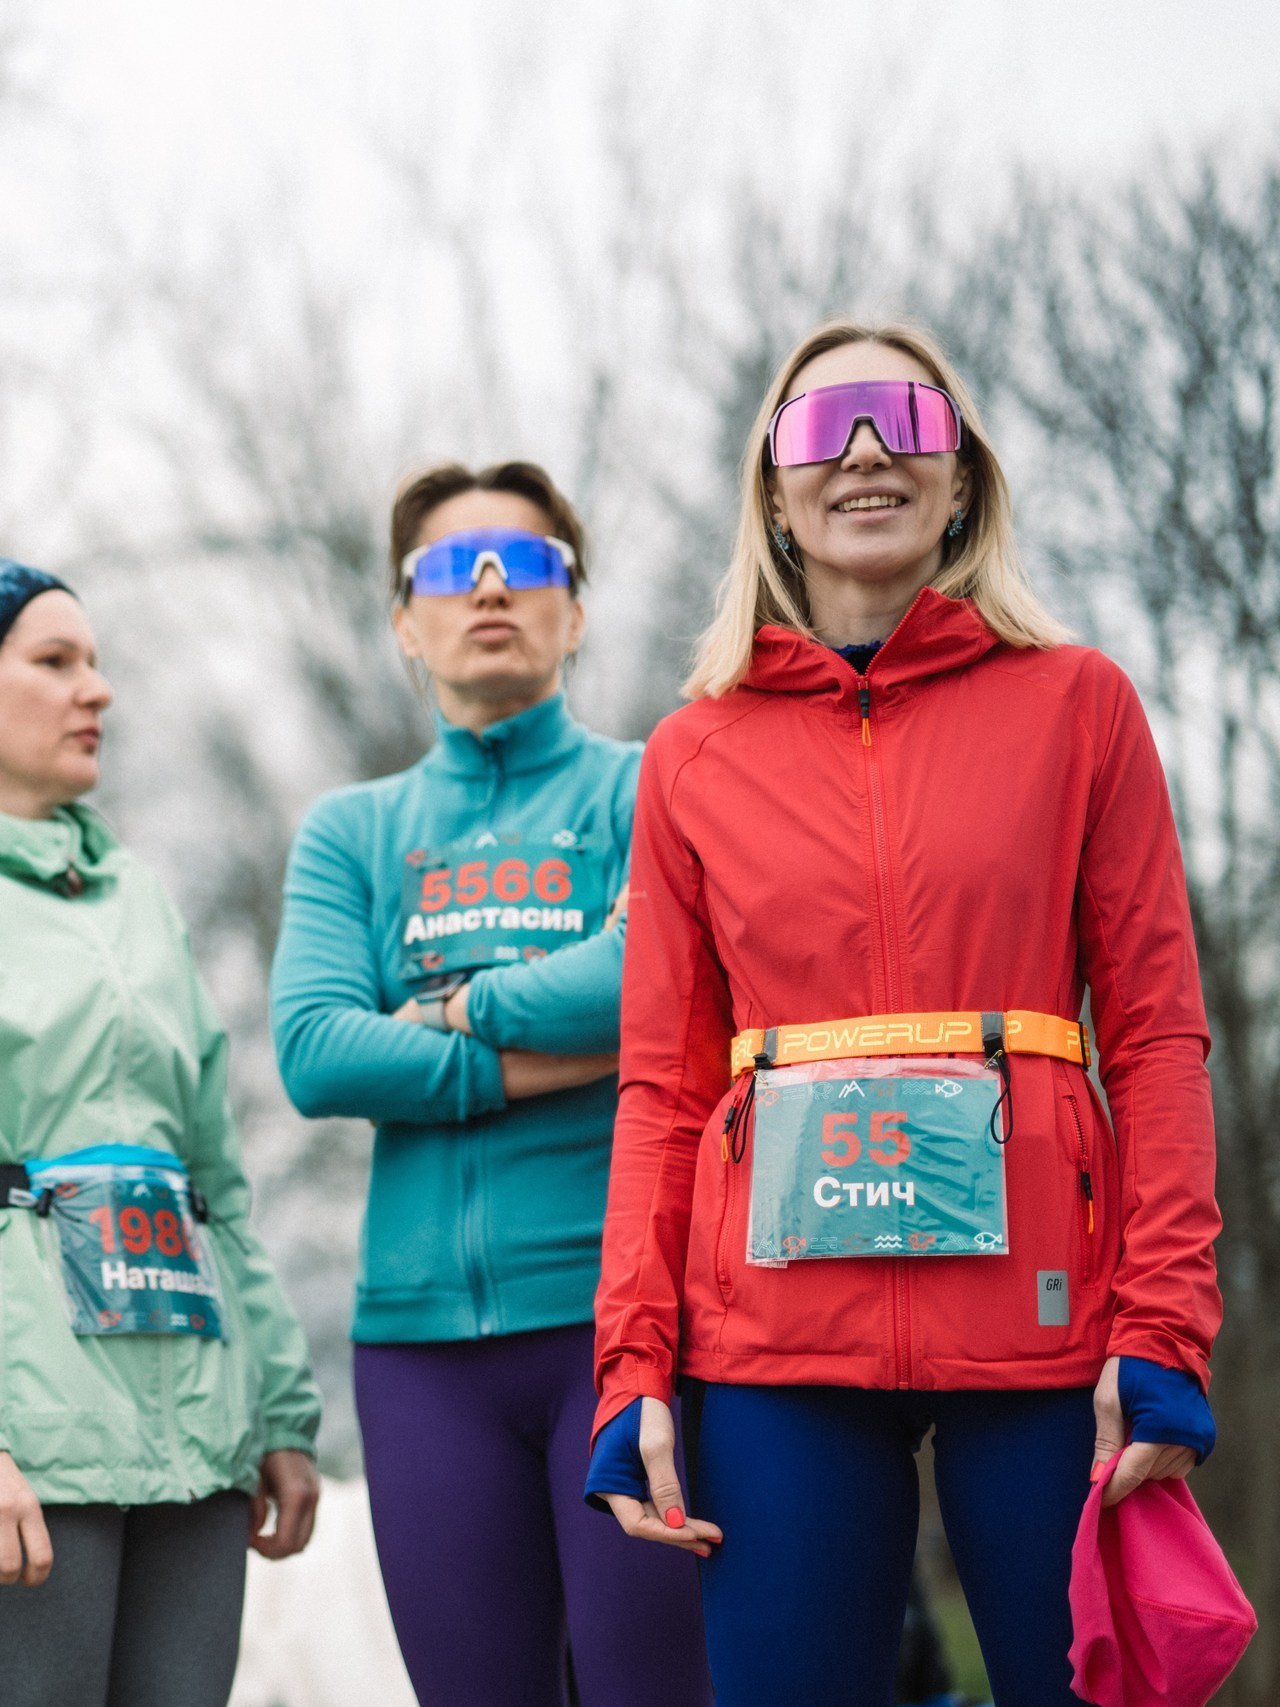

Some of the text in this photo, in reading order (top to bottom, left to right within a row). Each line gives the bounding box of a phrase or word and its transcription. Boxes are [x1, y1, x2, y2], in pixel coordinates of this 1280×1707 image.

[420, 858, 572, 912] 5566
[403, 906, 584, 946] Анастасия
[783, 1021, 973, 1055] POWERUP
[821, 1111, 912, 1168] 55
[813, 1176, 915, 1208] Стич
